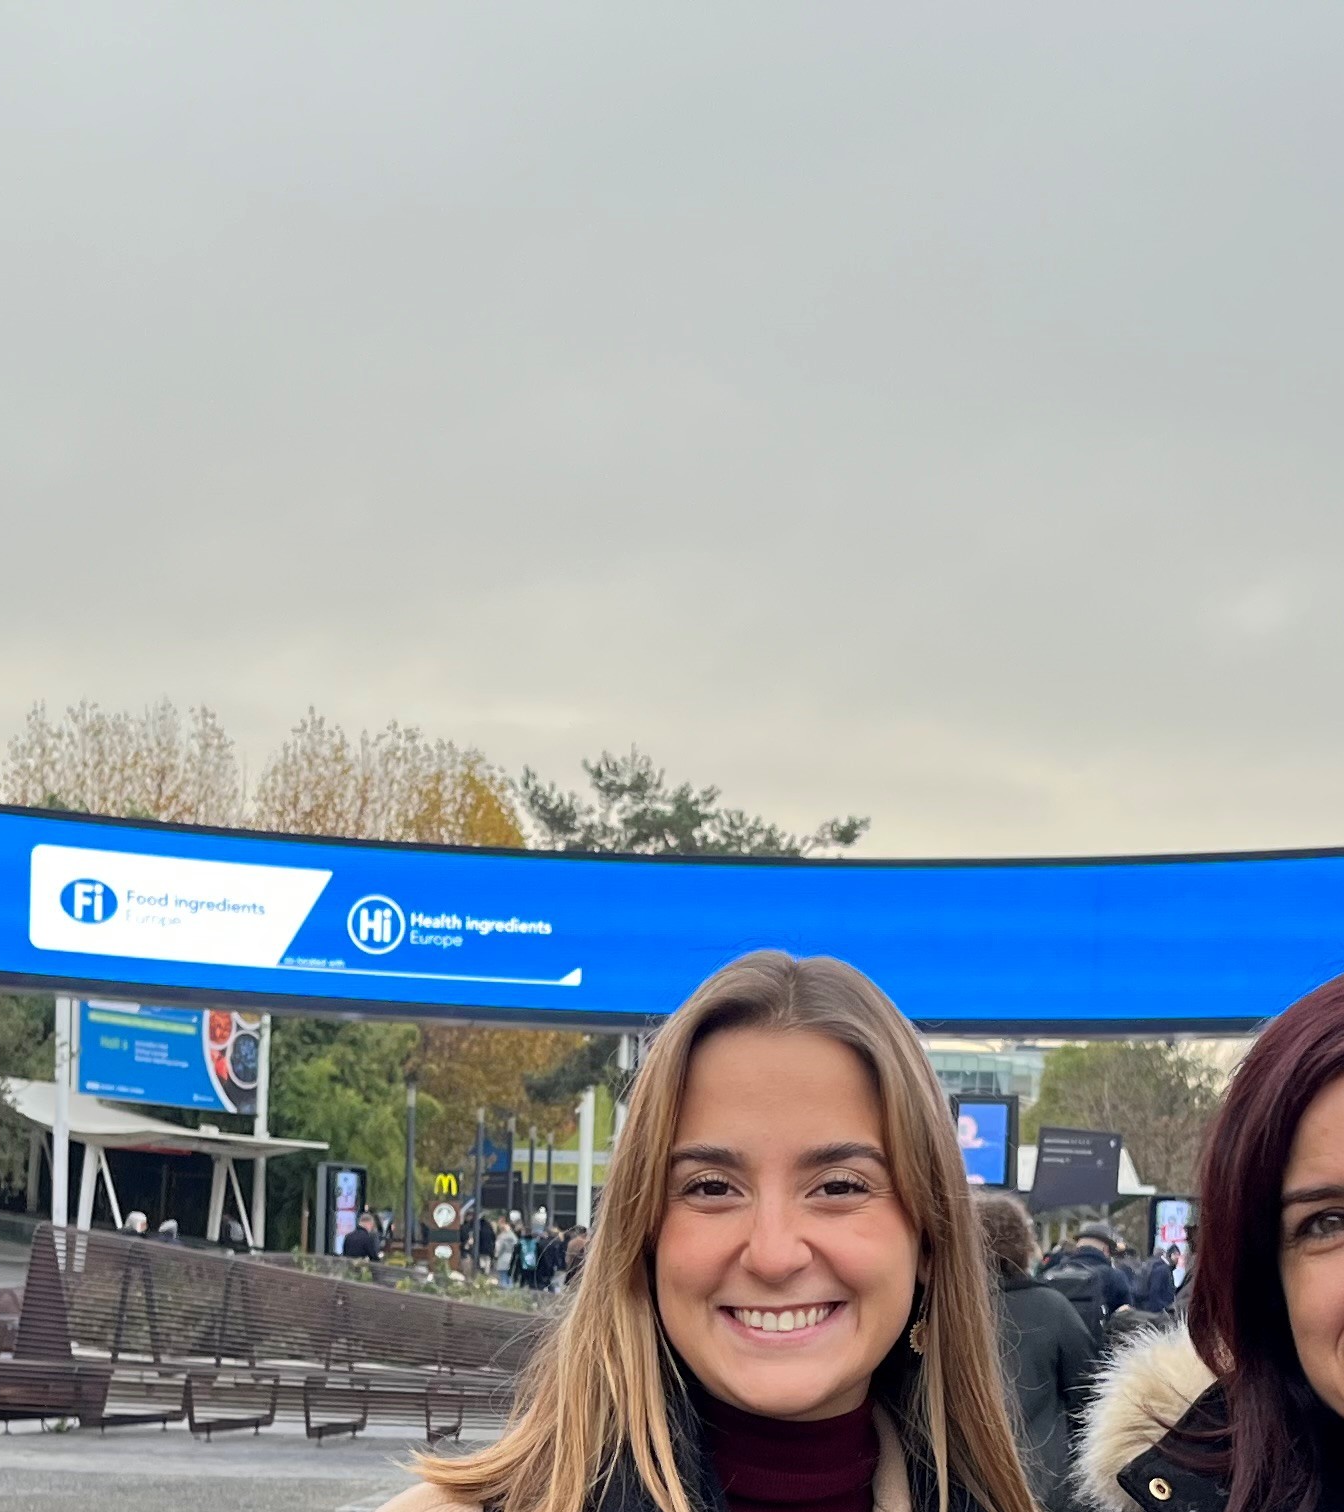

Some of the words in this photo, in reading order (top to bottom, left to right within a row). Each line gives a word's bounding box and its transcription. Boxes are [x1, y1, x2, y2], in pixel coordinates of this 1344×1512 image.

[73, 882, 104, 922] Fi
[127, 890, 169, 907] Food
[174, 896, 266, 916] ingredients
[359, 908, 392, 942] Hi
[410, 912, 462, 930] Health
[465, 916, 552, 935] ingredients
[410, 930, 463, 949] Europe
